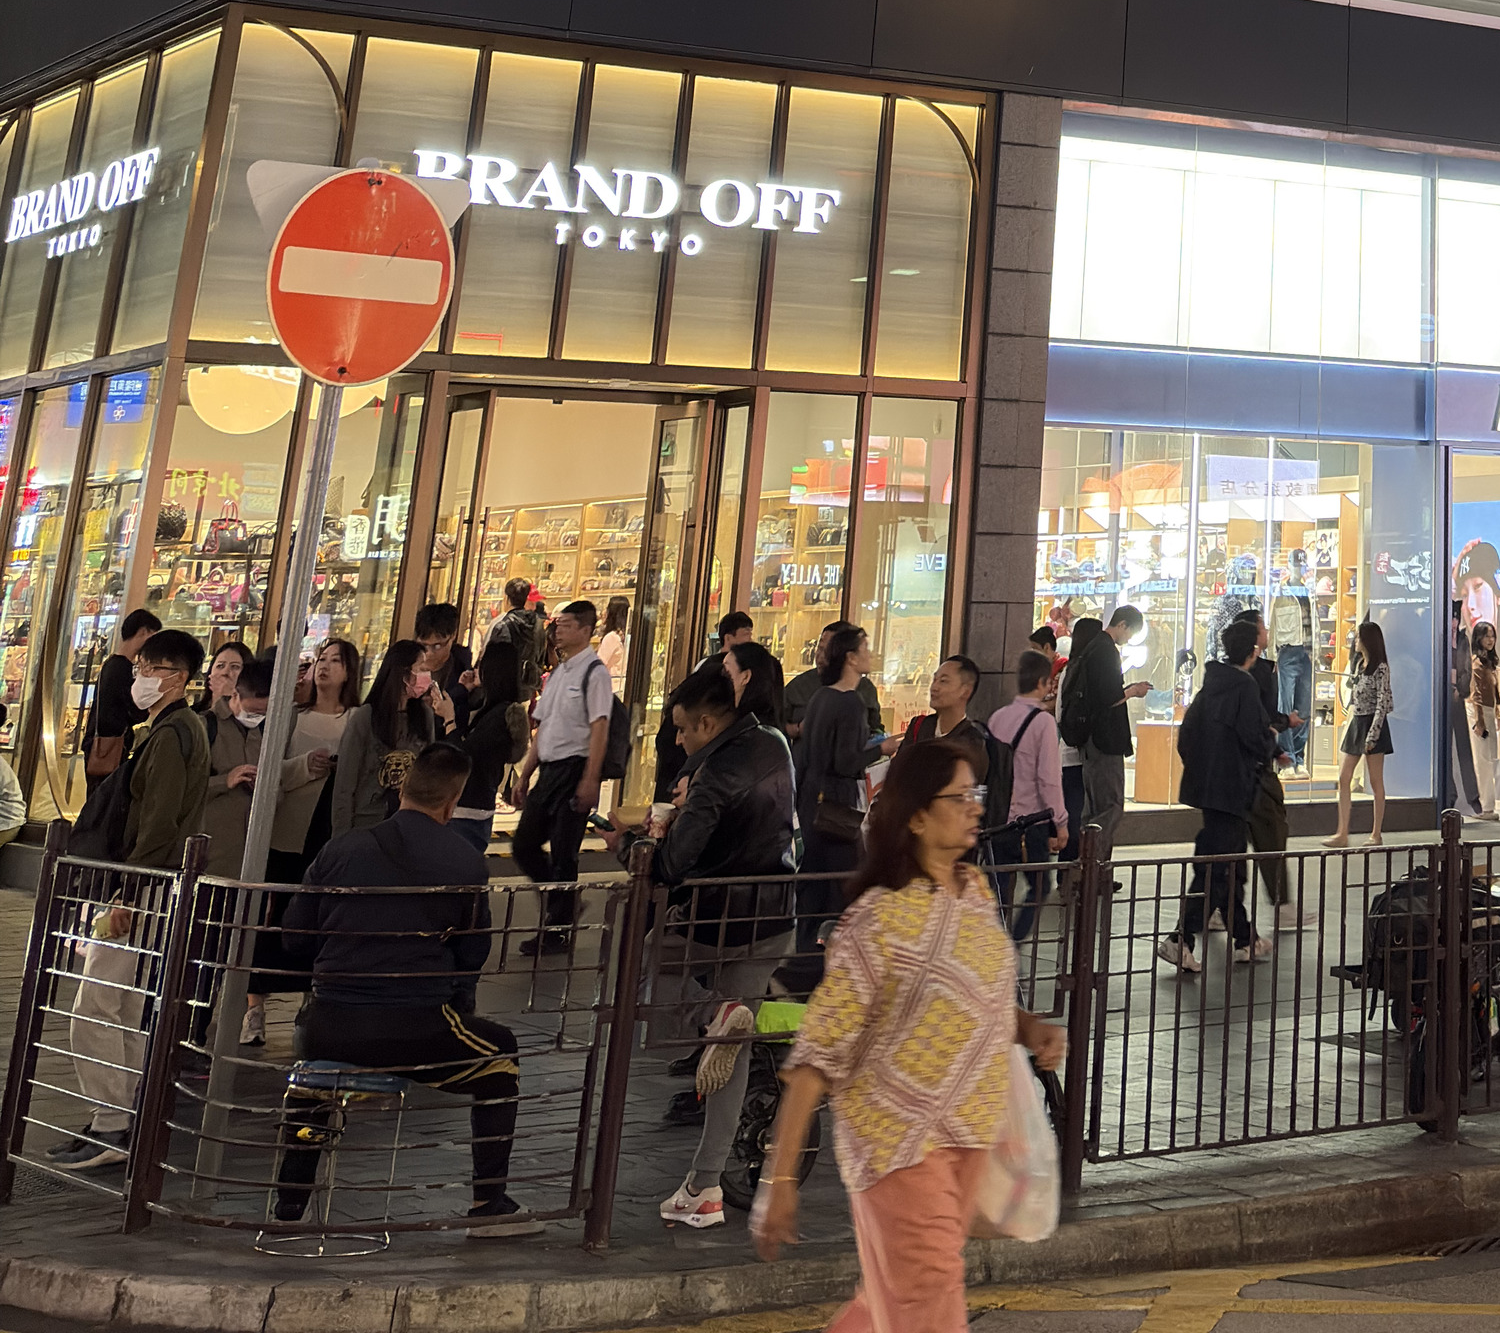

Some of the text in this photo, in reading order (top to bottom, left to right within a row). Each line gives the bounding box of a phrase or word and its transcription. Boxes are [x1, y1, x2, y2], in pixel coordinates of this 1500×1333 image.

[5, 147, 160, 243] BRAND OFF
[413, 149, 841, 234] BRAND OFF
[47, 224, 102, 259] TOKYO
[555, 223, 702, 257] TOKYO
